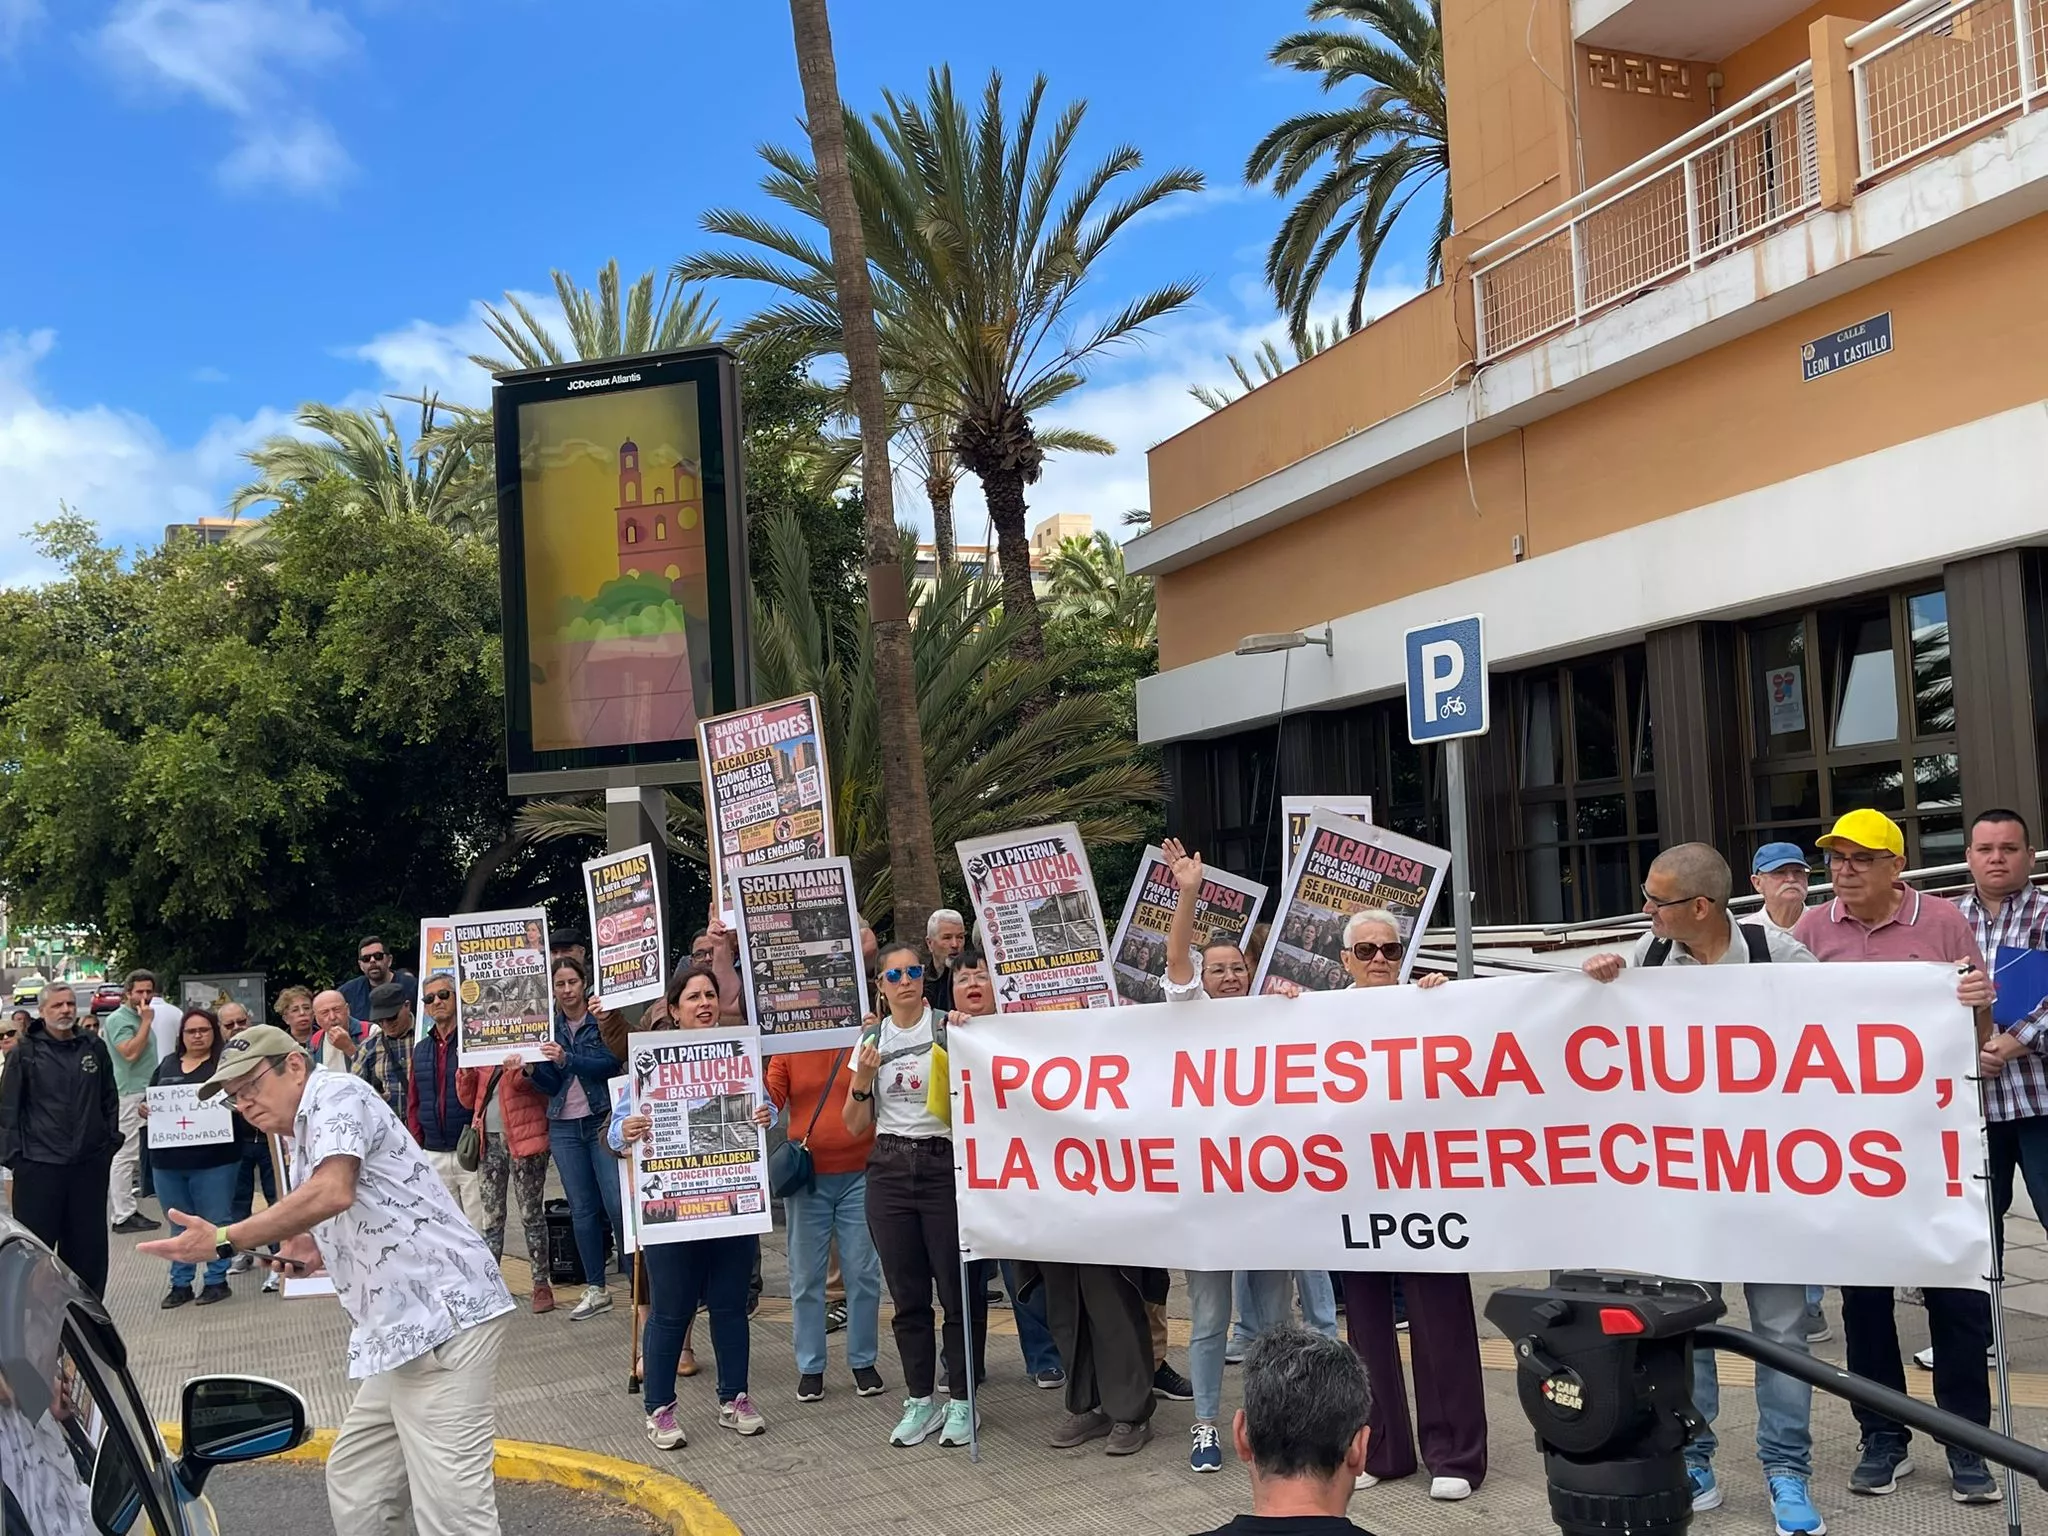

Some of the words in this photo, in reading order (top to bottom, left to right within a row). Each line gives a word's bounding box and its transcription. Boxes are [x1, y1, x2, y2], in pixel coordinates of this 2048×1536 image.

[1837, 325, 1866, 342] CALLE
[1807, 356, 1829, 377] LEON
[1834, 352, 1839, 367] Y
[1844, 335, 1887, 363] CASTILLO
[567, 378, 610, 390] JCDecaux
[611, 373, 641, 384] Atlantis
[1422, 640, 1464, 723] P
[715, 718, 750, 738] BARRIO
[752, 714, 764, 726] DE
[715, 733, 746, 759] LAS
[747, 714, 808, 749] TORRES
[717, 747, 772, 773] ALCALDESA
[751, 760, 771, 778] ESTÁ
[719, 789, 731, 799] TU
[733, 773, 774, 796] PROMESA
[803, 784, 813, 792] NO
[722, 806, 733, 814] QUE
[760, 793, 775, 802] CASAS
[724, 810, 742, 821] NO
[748, 801, 772, 814] SERÁN
[747, 848, 765, 864] MÁS
[767, 839, 806, 858] ENGAÑOS
[988, 853, 1005, 867] LA
[1005, 841, 1058, 864] PATERNA
[1315, 832, 1423, 886] ALCALDESA
[593, 871, 600, 887] 7
[603, 857, 647, 884] PALMAS
[991, 866, 1017, 890] EN
[1019, 853, 1082, 884] LUCHA
[1307, 862, 1325, 876] LAS
[1326, 868, 1357, 888] CASAS
[1358, 880, 1372, 892] DE
[1310, 852, 1338, 868] PARA
[1340, 862, 1382, 884] CUANDO
[603, 881, 620, 892] NUEVA
[621, 874, 640, 887] CIUDAD
[741, 869, 841, 893] SCHAMANN
[1146, 881, 1170, 896] PARA
[745, 890, 793, 906] EXISTE
[1004, 886, 1041, 902] ¡BASTA
[1043, 881, 1063, 896] YA!
[1143, 892, 1159, 904] LAS
[1302, 890, 1329, 907] PARA
[1332, 898, 1342, 910] EL
[1305, 879, 1319, 891] SE
[1322, 884, 1383, 909] ENTREGARAN
[746, 904, 788, 914] COMERCIOS
[1141, 906, 1154, 917] SE
[1138, 916, 1163, 930] PARA
[457, 926, 481, 940] REINA
[770, 950, 806, 958] IMPUESTOS
[1000, 961, 1034, 974] ¡BASTA
[1035, 958, 1049, 969] YA,
[1050, 950, 1099, 968] ALCALDESA!
[470, 971, 491, 979] PARA
[504, 965, 544, 976] COLECTOR?
[476, 962, 493, 970] LOS
[602, 968, 607, 977] 7
[609, 959, 640, 976] PALMAS
[1024, 964, 1097, 983] CONCENTRACIÓN
[602, 976, 615, 986] DICE
[615, 972, 634, 984] BASTA
[603, 982, 633, 994] SOLUCIONES
[777, 1011, 789, 1022] NO
[792, 1010, 810, 1021] MAS
[482, 1026, 507, 1036] MARC
[509, 1022, 549, 1034] ANTHONY
[775, 1020, 838, 1033] ALCALDESA.
[660, 1049, 676, 1063] LA
[679, 1043, 733, 1062] PATERNA
[659, 1064, 684, 1086] EN
[690, 1056, 753, 1083] LUCHA
[1170, 1031, 1545, 1108] NUESTRA
[149, 1092, 165, 1100] LAS
[666, 1084, 707, 1100] ¡BASTA
[709, 1083, 729, 1095] YA!
[151, 1104, 164, 1113] DE
[190, 1101, 218, 1111] LAJA
[152, 1129, 231, 1143] ABANDONADAS
[647, 1159, 683, 1171] ¡BASTA
[685, 1157, 700, 1168] YA,
[702, 1150, 754, 1166] ALCALDESA!
[964, 1137, 1040, 1190] LA
[1054, 1136, 1180, 1196] QUE
[1200, 1133, 1349, 1193] NOS
[1369, 1122, 1908, 1198] MERECEMOS
[671, 1165, 751, 1181] CONCENTRACIÓN
[359, 1216, 398, 1236] Panama
[1341, 1211, 1470, 1250] LPGC
[1555, 1380, 1580, 1397] CAM
[1555, 1393, 1583, 1410] GEAR
